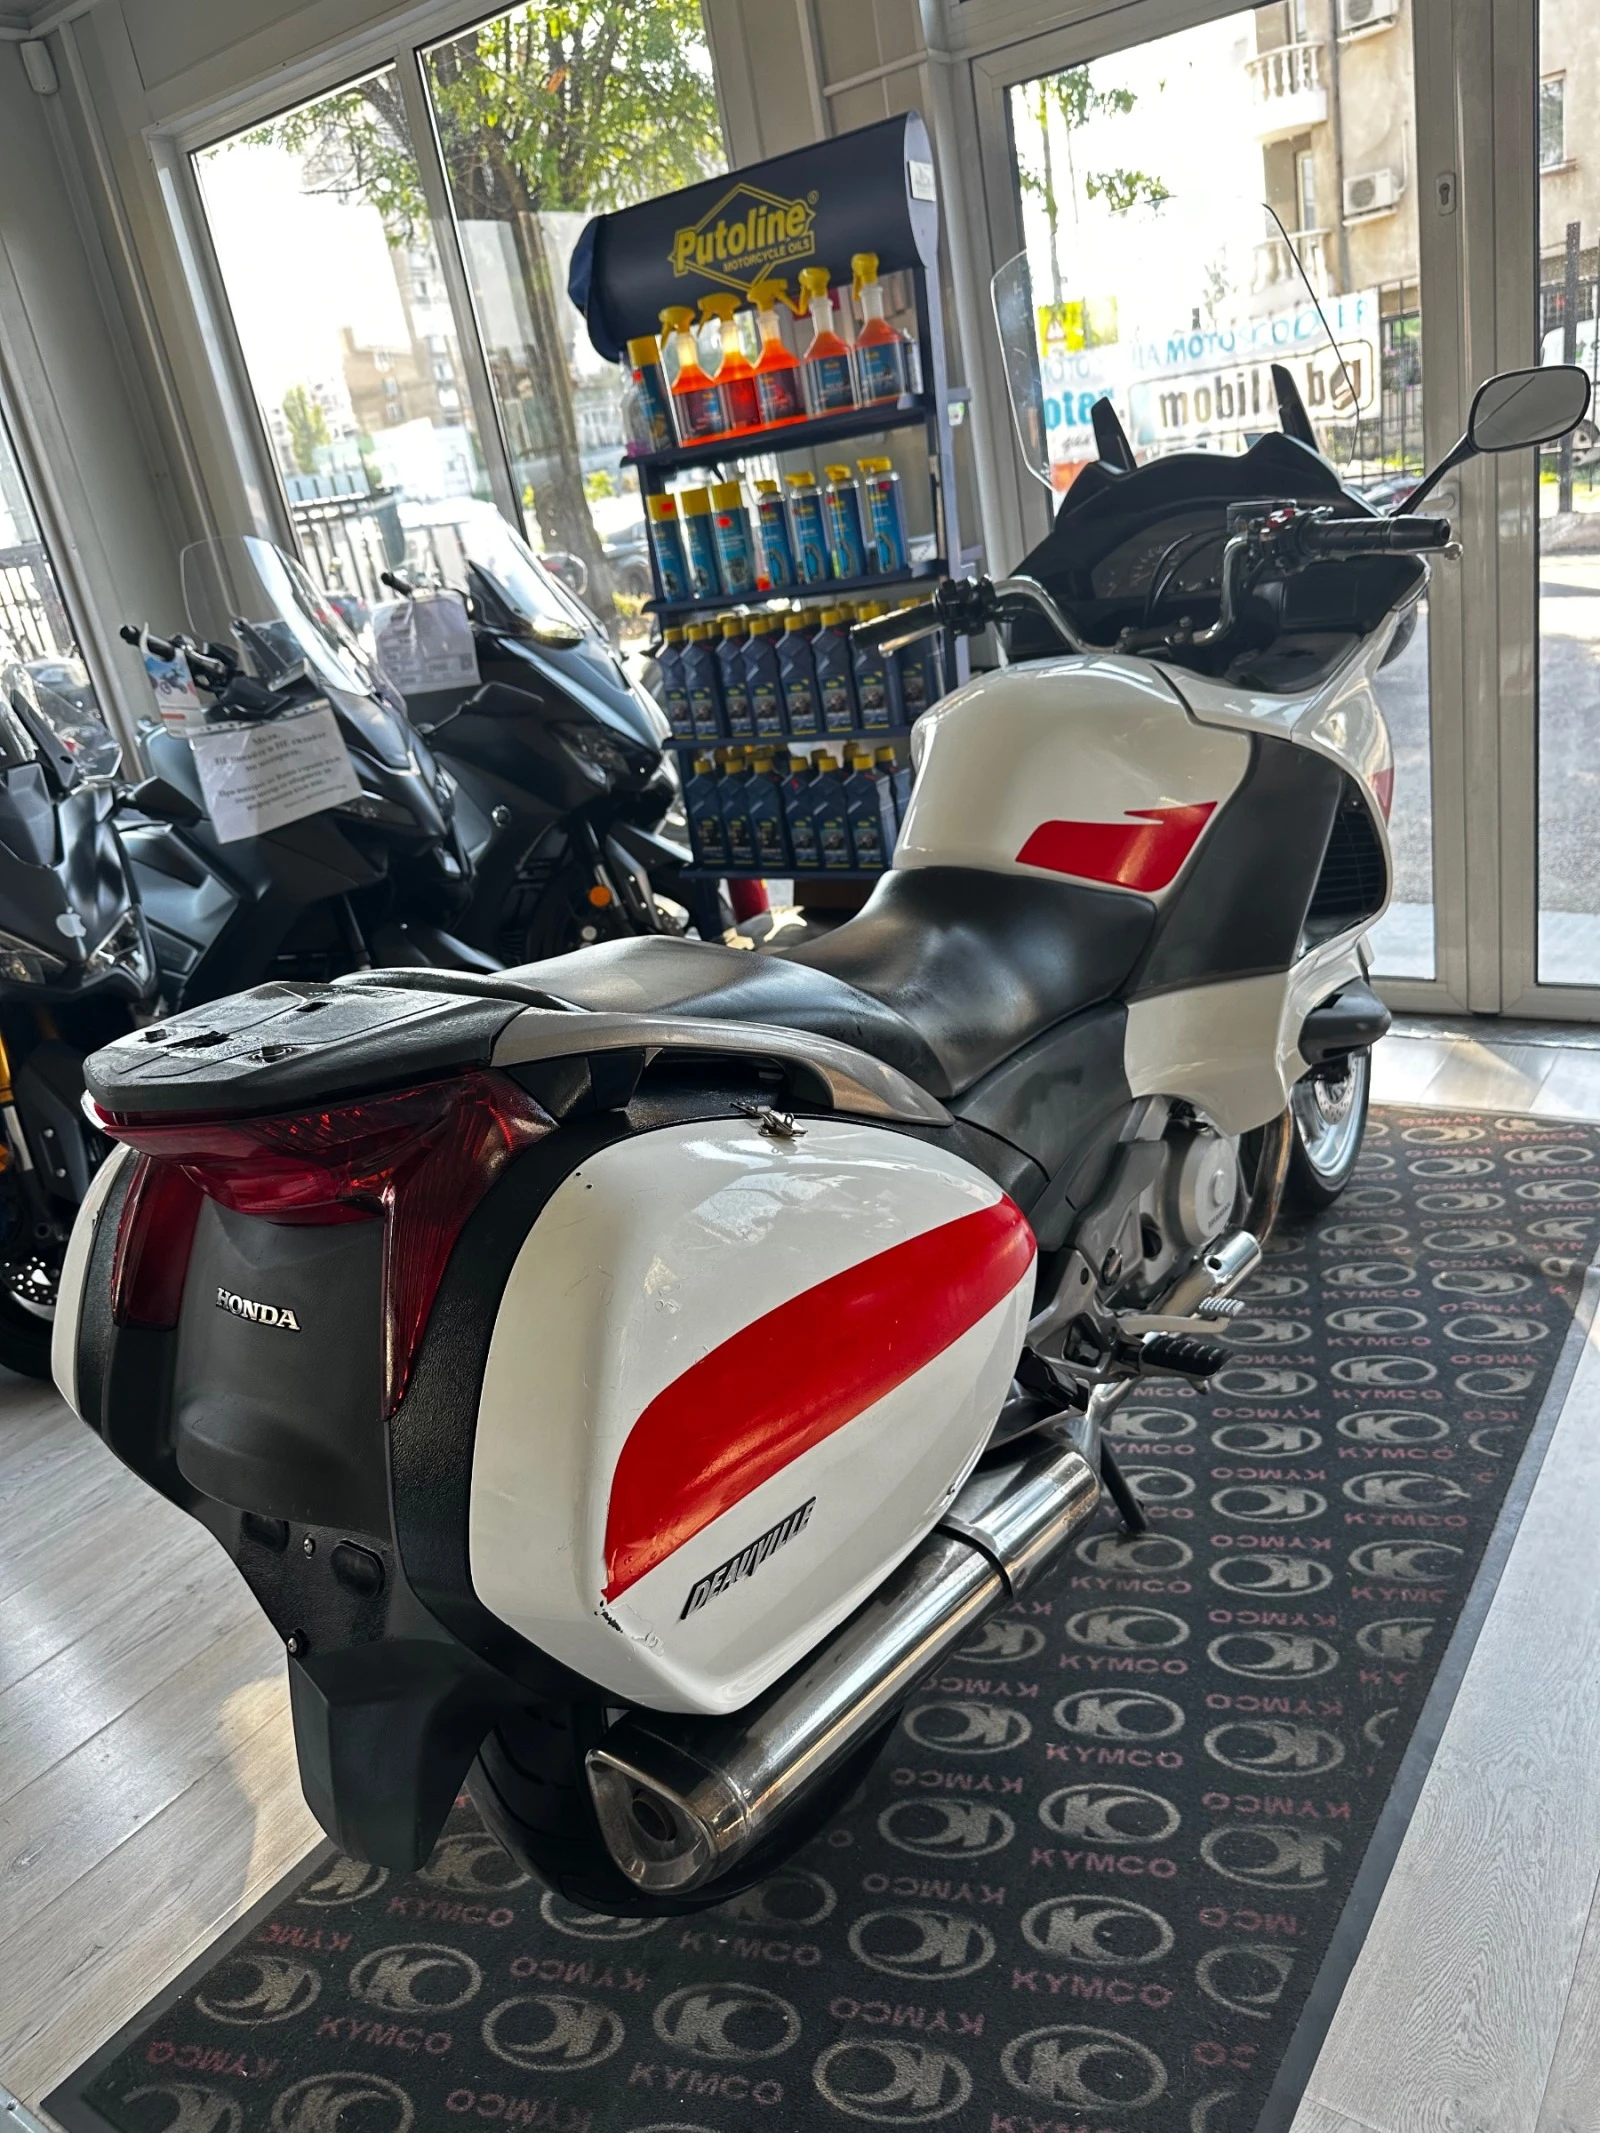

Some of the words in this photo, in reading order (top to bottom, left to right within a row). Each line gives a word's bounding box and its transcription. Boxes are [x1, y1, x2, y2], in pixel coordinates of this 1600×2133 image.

[676, 204, 807, 273] Putoline
[723, 247, 787, 273] MOTORCYCLE
[787, 237, 811, 252] OILS
[1520, 1202, 1600, 1212] KYMC
[1321, 1288, 1421, 1299] KYMCO
[216, 1286, 301, 1332] HONDA
[1327, 1336, 1431, 1347] KYMCO
[1333, 1389, 1443, 1400] KYMCO
[1212, 1407, 1321, 1419] KYMCO
[1110, 1442, 1196, 1455] YMCO
[1338, 1447, 1456, 1460] KYMCO
[1211, 1467, 1327, 1480] KYMCO
[1210, 1535, 1331, 1549] KYMCO
[680, 1497, 816, 1620] DEAUVILLE
[1071, 1576, 1192, 1593] KYMCO
[1208, 1609, 1337, 1627] KYMCO
[1059, 1653, 1188, 1675] KYMCO
[1205, 1694, 1344, 1715] KYMCO
[1045, 1742, 1184, 1769] KYMCO
[890, 1768, 1024, 1794] KYMCO
[1202, 1792, 1351, 1821] KYMCO
[1030, 1848, 1177, 1878] KYMCO
[863, 1873, 1006, 1905] KYMCO
[510, 1956, 649, 1992] KYMCO
[1012, 1967, 1175, 2008] KYMCO
[829, 1998, 986, 2037] KYMCO
[317, 2018, 450, 2055] KYMCO
[627, 2061, 784, 2105] KYMCO
